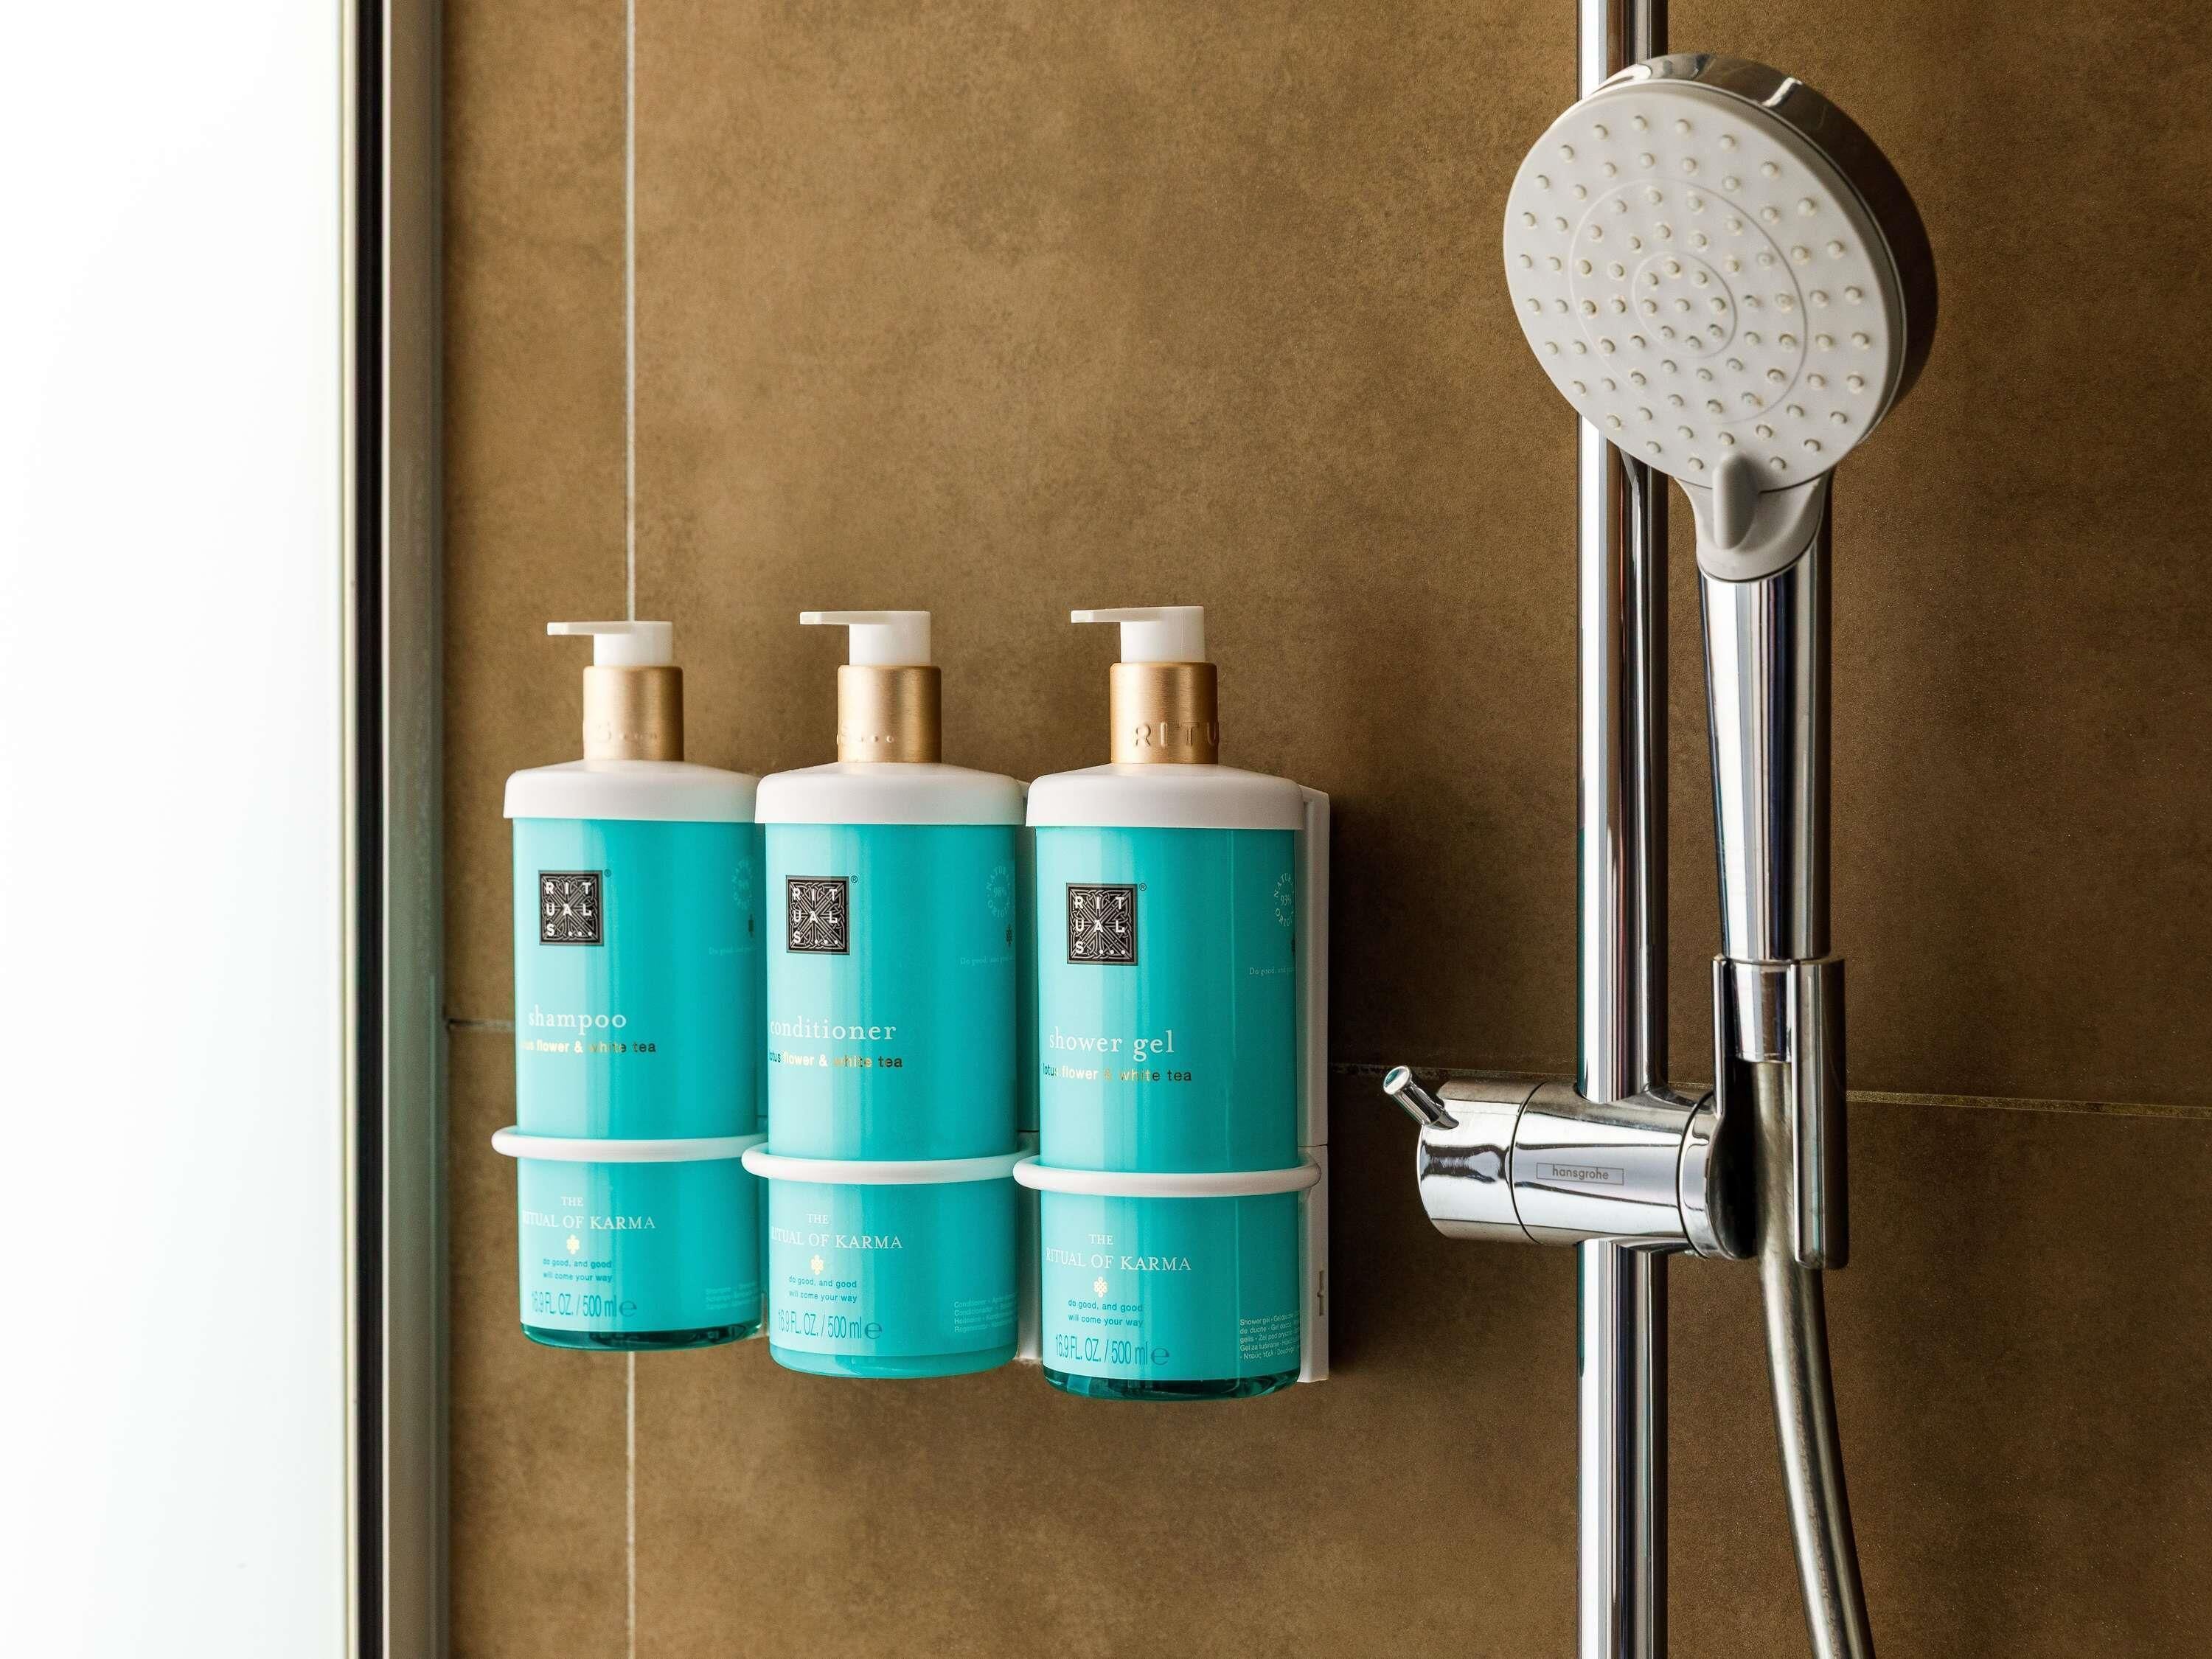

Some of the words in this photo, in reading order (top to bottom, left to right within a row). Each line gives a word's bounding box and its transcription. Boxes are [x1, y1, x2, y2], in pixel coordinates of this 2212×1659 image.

[529, 1004, 627, 1036] shampoo
[770, 1015, 897, 1040] conditioner
[537, 1039, 570, 1053] flower
[574, 1040, 584, 1054] &
[589, 1040, 627, 1054] white
[633, 1041, 656, 1053] tea
[1049, 1026, 1123, 1053] shower
[1133, 1029, 1175, 1062] gel
[784, 1051, 815, 1066] flower
[818, 1054, 828, 1068] &
[878, 1055, 903, 1068] tea
[1043, 1062, 1058, 1077] lotus
[1062, 1065, 1099, 1080] flower
[1120, 1068, 1161, 1082] white
[1167, 1070, 1192, 1082] tea
[1552, 1164, 1609, 1180] hansgrohe
[560, 1196, 584, 1207] THE
[563, 1215, 585, 1228] OF
[590, 1216, 656, 1230] KARMA
[806, 1213, 830, 1225] THE
[809, 1233, 831, 1248] OF
[835, 1235, 903, 1249] KARMA
[1088, 1234, 1114, 1245] THE
[591, 1260, 612, 1270] good
[1046, 1247, 1086, 1267] RITUAL
[1091, 1253, 1114, 1269] OF
[1120, 1255, 1192, 1271] KARMA
[554, 1272, 574, 1280] come
[576, 1273, 593, 1282] your
[595, 1274, 613, 1283] way
[835, 1280, 858, 1290] good
[582, 1295, 602, 1318] 500
[604, 1294, 617, 1318] ml
[821, 1293, 838, 1302] your
[840, 1295, 858, 1304] way
[1068, 1298, 1077, 1307] do
[1102, 1303, 1117, 1311] and
[1120, 1304, 1144, 1313] good
[821, 1313, 827, 1338] /
[827, 1315, 846, 1338] 500
[849, 1316, 862, 1339] ml
[1068, 1313, 1079, 1321] will
[1081, 1315, 1102, 1324] come
[1104, 1318, 1123, 1326] your
[1125, 1319, 1144, 1328] way
[1055, 1333, 1069, 1358] 16.9
[1071, 1335, 1082, 1360] FL.
[1085, 1337, 1102, 1363] OZ.
[1104, 1338, 1110, 1363] /
[1111, 1340, 1132, 1364] 500
[1135, 1340, 1148, 1365] ml
